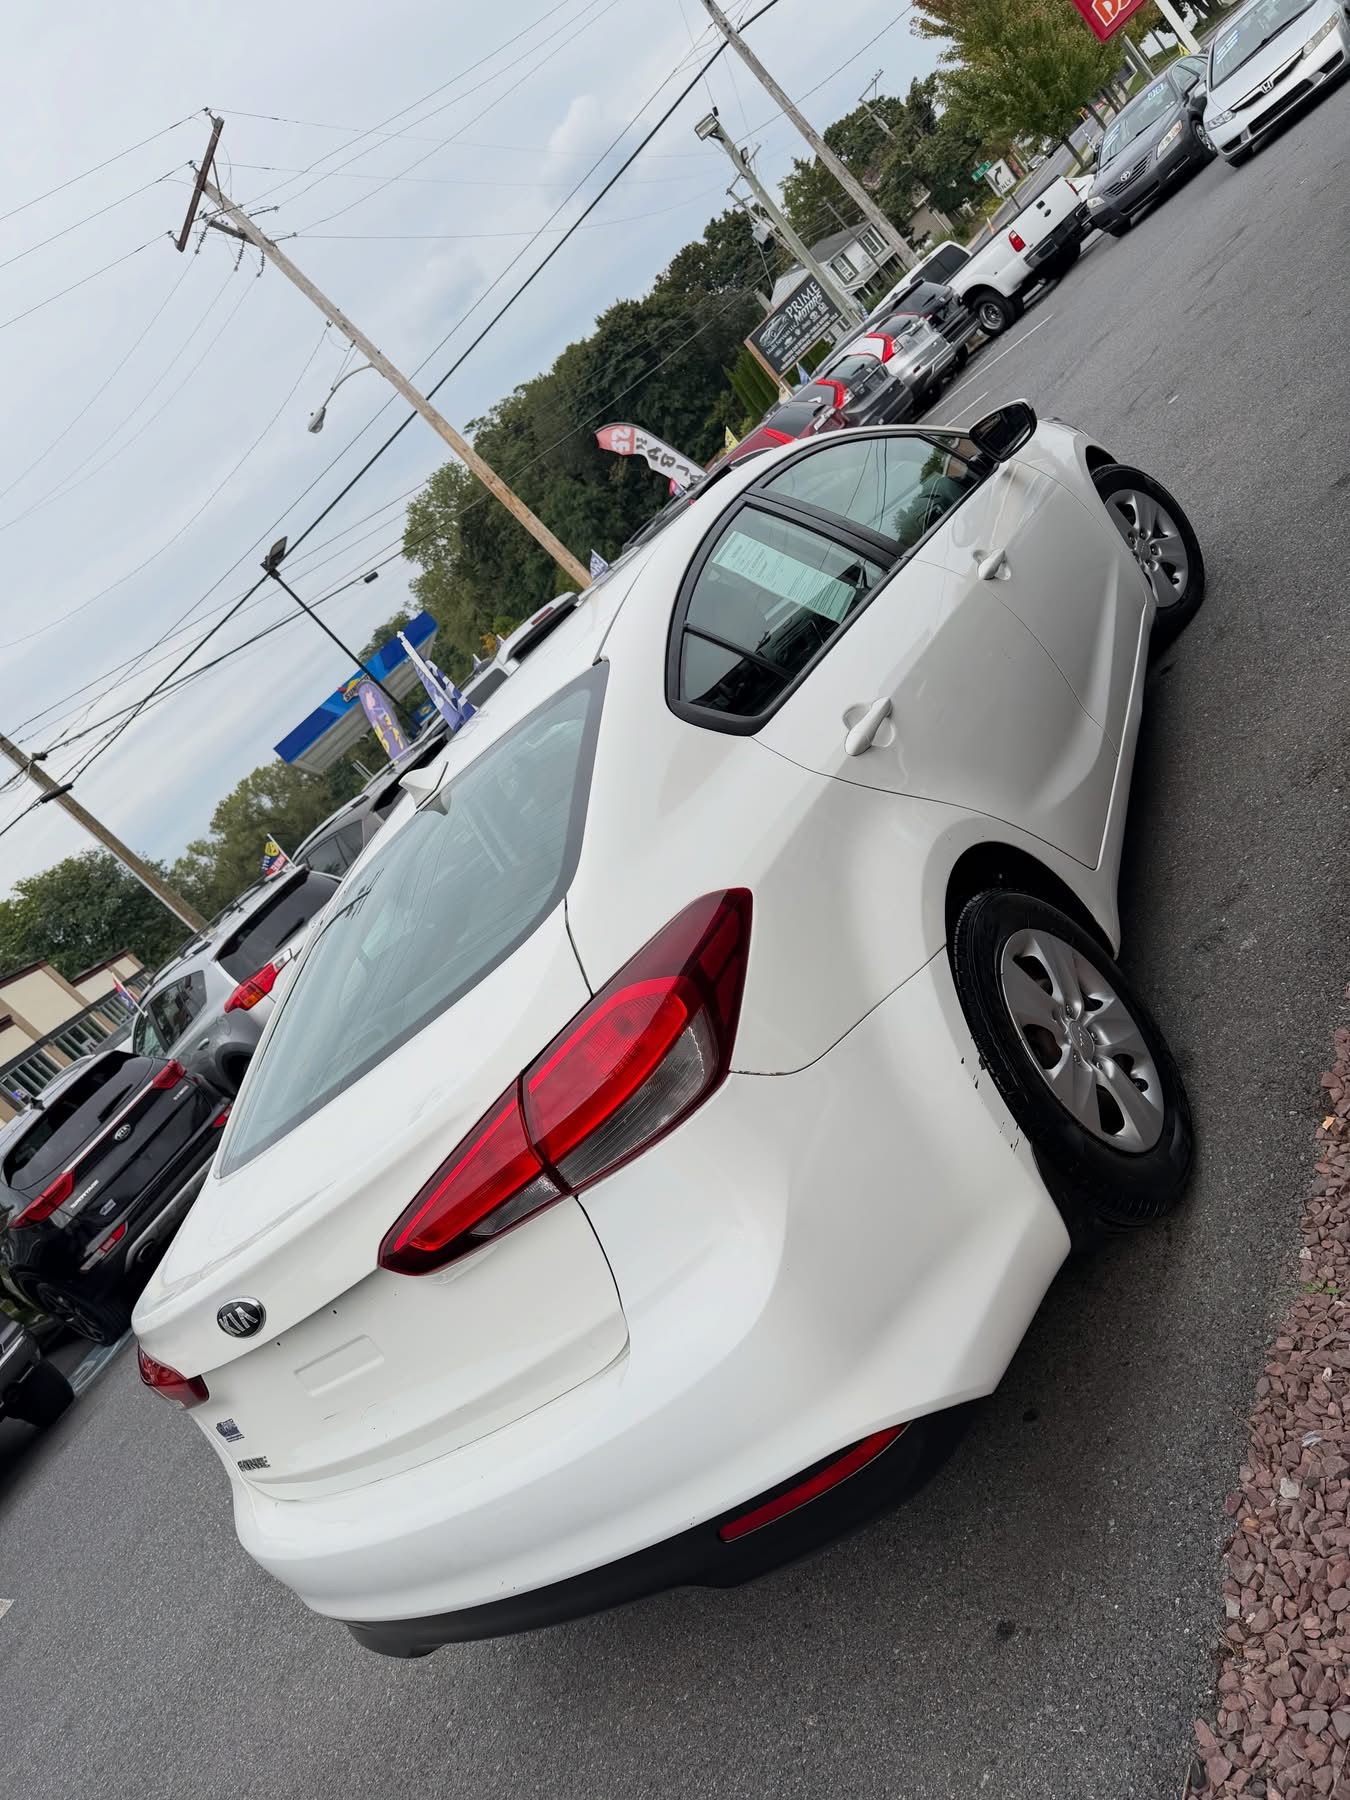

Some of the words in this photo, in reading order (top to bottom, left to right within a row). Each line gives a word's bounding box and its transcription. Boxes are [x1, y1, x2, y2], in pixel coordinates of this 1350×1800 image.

[784, 281, 821, 318] PRIME
[793, 291, 824, 327] MOTORS
[218, 1305, 260, 1336] KIA
